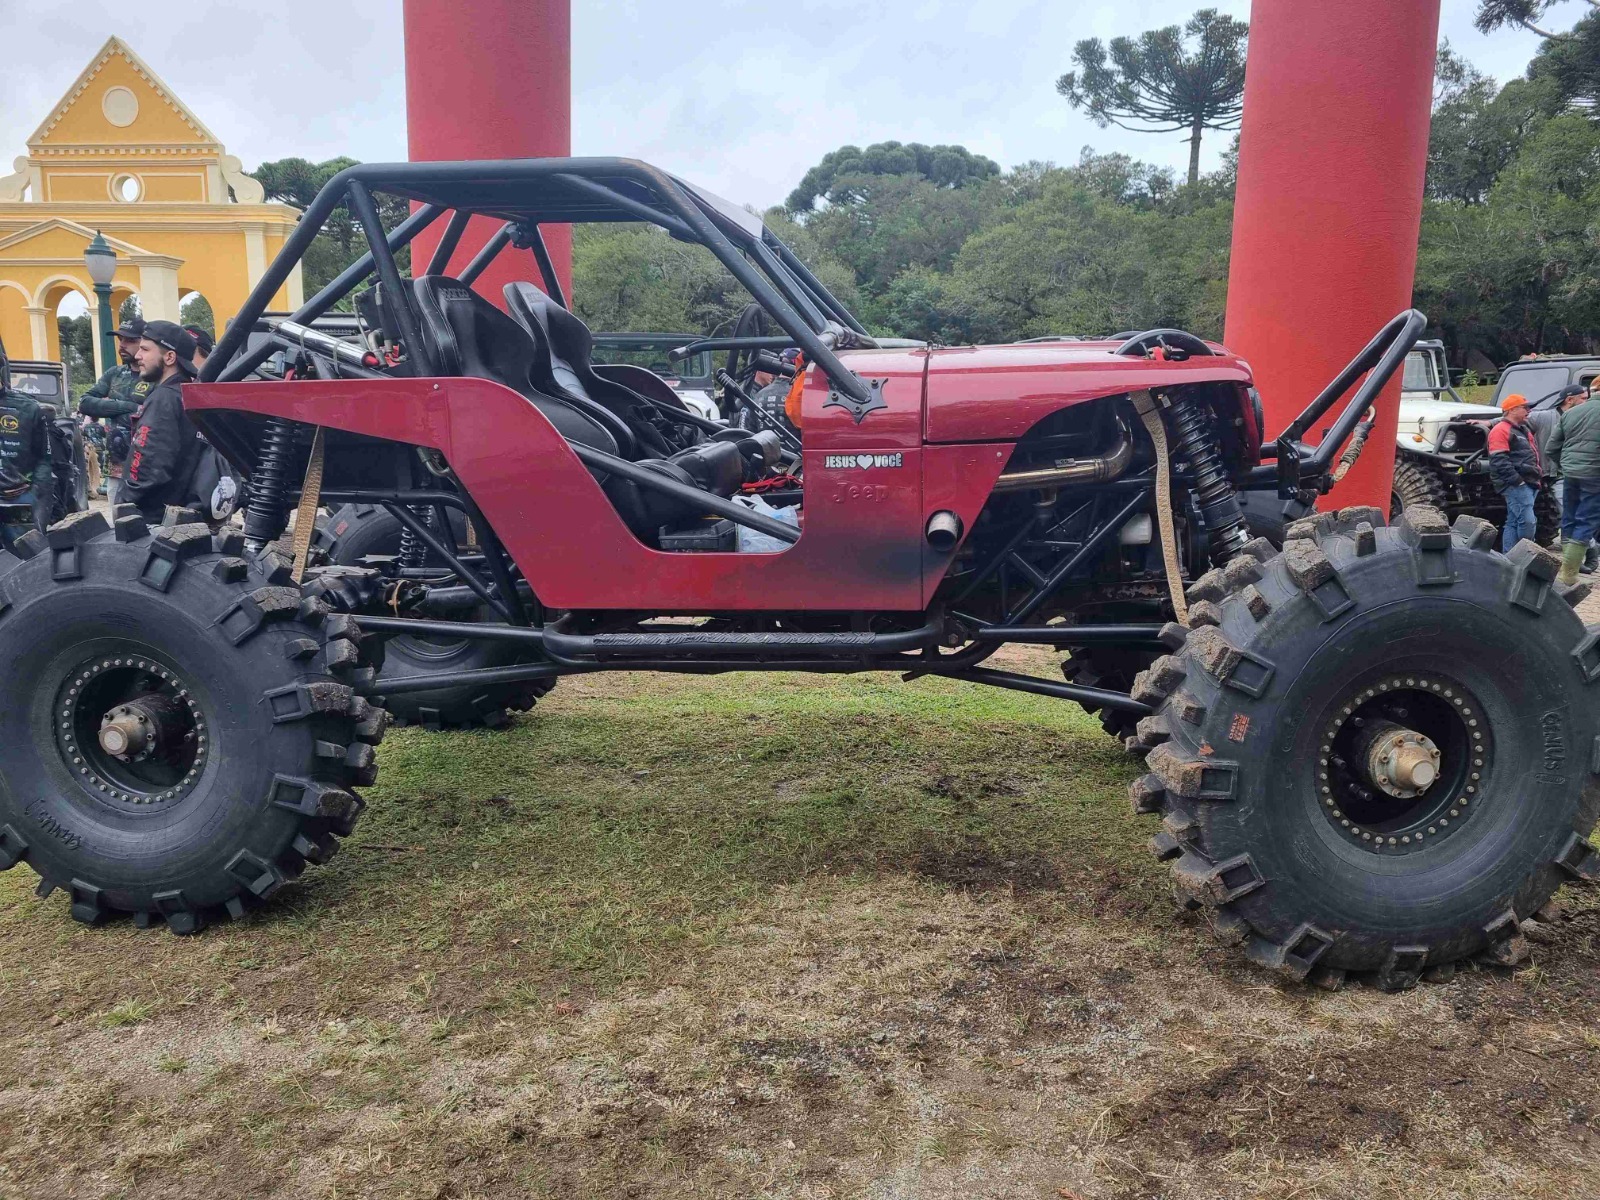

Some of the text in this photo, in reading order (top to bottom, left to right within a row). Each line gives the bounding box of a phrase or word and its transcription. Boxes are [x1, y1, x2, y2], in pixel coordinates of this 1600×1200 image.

[825, 452, 902, 468] JESUS VOCÊ
[832, 482, 889, 503] Jeep
